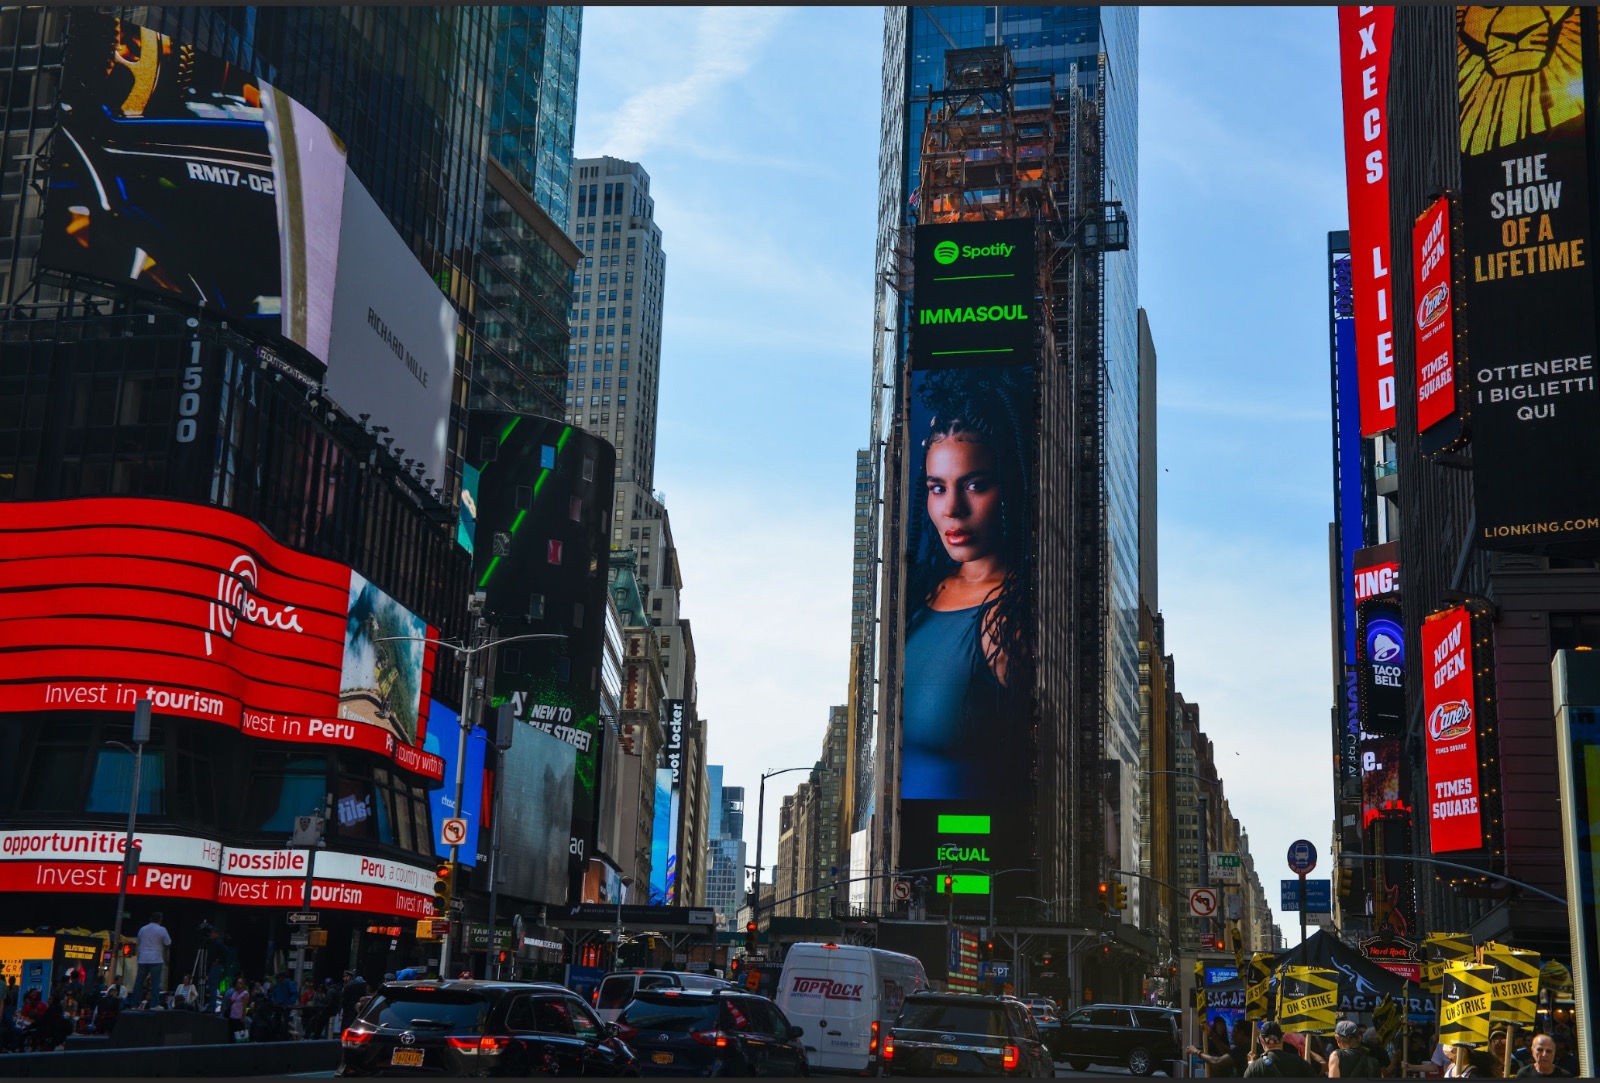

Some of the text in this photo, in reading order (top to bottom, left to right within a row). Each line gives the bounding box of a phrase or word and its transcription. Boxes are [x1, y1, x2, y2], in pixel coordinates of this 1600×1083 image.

[185, 161, 275, 195] RM17-02
[1501, 152, 1548, 187] THE
[1490, 181, 1562, 220] SHOW
[1421, 210, 1443, 262] NOW
[1501, 214, 1554, 248] OF A
[962, 242, 1013, 259] Spotify
[1421, 235, 1445, 282] OPEN
[1474, 239, 1585, 283] LIFETIME
[920, 304, 1028, 325] IMMASOUL
[367, 306, 428, 389] RICHARD MILLE
[1421, 351, 1449, 382] TIMES
[1477, 355, 1593, 384] OTTENERE
[176, 340, 202, 443] 1500
[1419, 367, 1452, 402] SQUARE
[1478, 376, 1594, 404] I BIGLIETTI
[1516, 403, 1555, 421] QUI
[1484, 517, 1599, 538] LIONKING.COM
[1433, 621, 1462, 667] NOW
[1372, 664, 1401, 677] TACO
[1374, 675, 1402, 688] BELL
[1434, 648, 1467, 689] OPEN
[45, 684, 224, 716] Invest in tourism
[531, 704, 572, 723] NEW TO
[282, 715, 301, 736] in
[308, 719, 355, 740] Peru
[668, 702, 683, 751] Locker
[1431, 699, 1471, 740] Cane's
[553, 724, 592, 753] STREET
[398, 746, 421, 770] country
[422, 754, 438, 773] with
[1435, 777, 1472, 799] TIMES
[1432, 797, 1478, 820] SQUARE
[3, 832, 143, 856] opportunities
[937, 847, 990, 862] EQUAL
[228, 851, 304, 871] possible
[1224, 857, 1233, 866] 44
[36, 865, 108, 887] Invest
[145, 868, 193, 890] Peru
[217, 877, 363, 905] Invest in tourism
[396, 892, 416, 912] Invest
[1369, 946, 1408, 957] Hard Rock
[1502, 981, 1534, 997] STRIKE
[1287, 994, 1333, 1014] ON STRIKE
[1446, 997, 1487, 1021] ON STRIKE
